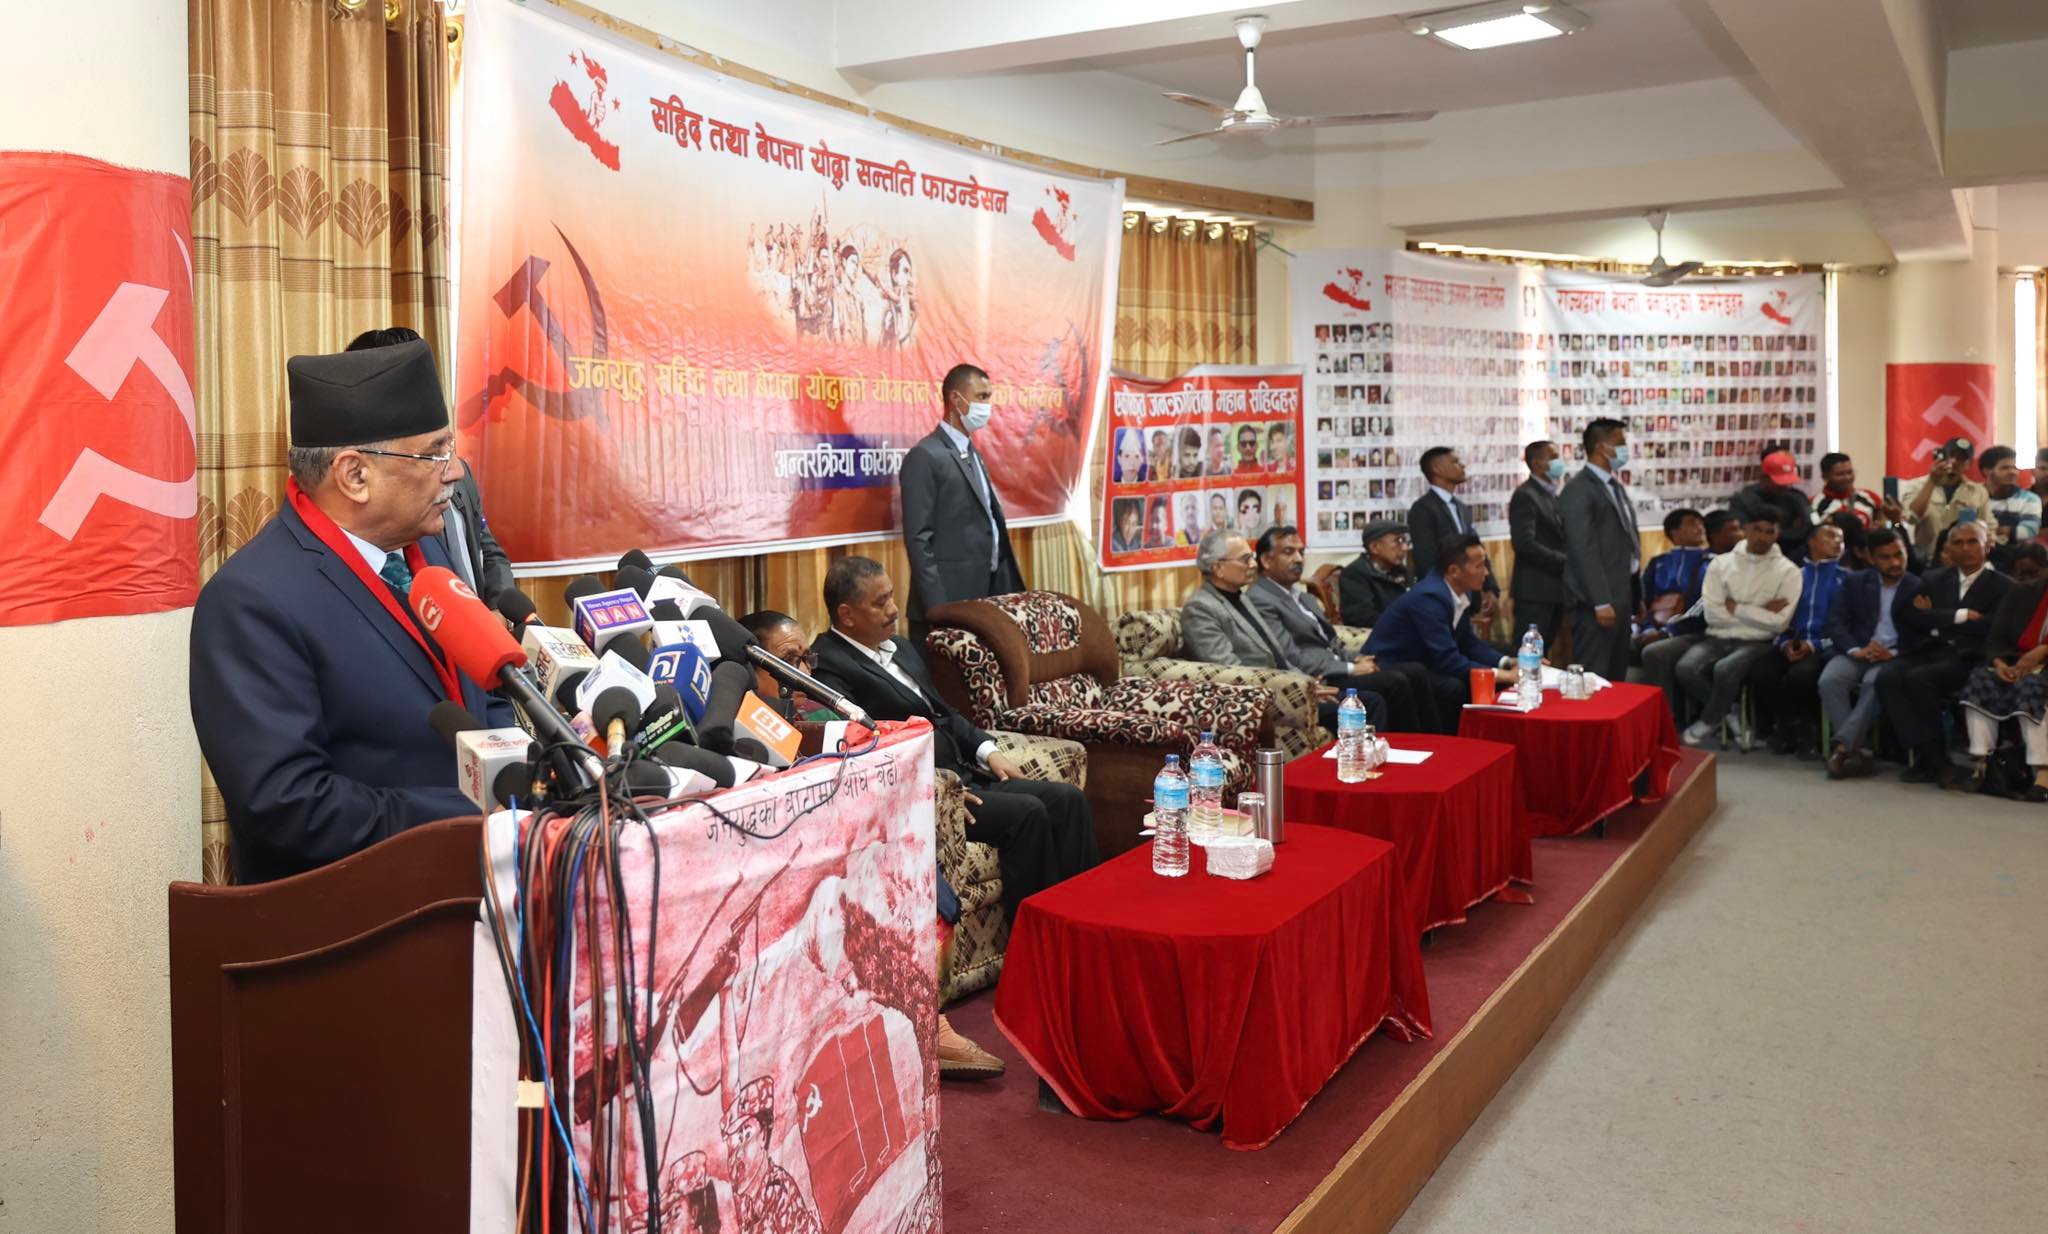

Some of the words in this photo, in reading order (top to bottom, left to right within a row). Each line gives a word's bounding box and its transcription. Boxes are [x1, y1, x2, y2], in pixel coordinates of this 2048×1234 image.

[651, 95, 703, 151] सहिद
[709, 118, 749, 158] तथा
[756, 122, 804, 172] बेपत्ता
[810, 139, 849, 191] योद्धा
[856, 159, 916, 197] सन्तति
[921, 175, 1009, 214] फाउन्डेसन
[713, 367, 750, 399] तथा
[1216, 389, 1247, 415] महान
[775, 442, 855, 479] अन्तरक्रिया
[859, 440, 912, 477] कार्यक्र
[592, 603, 643, 626] NAN
